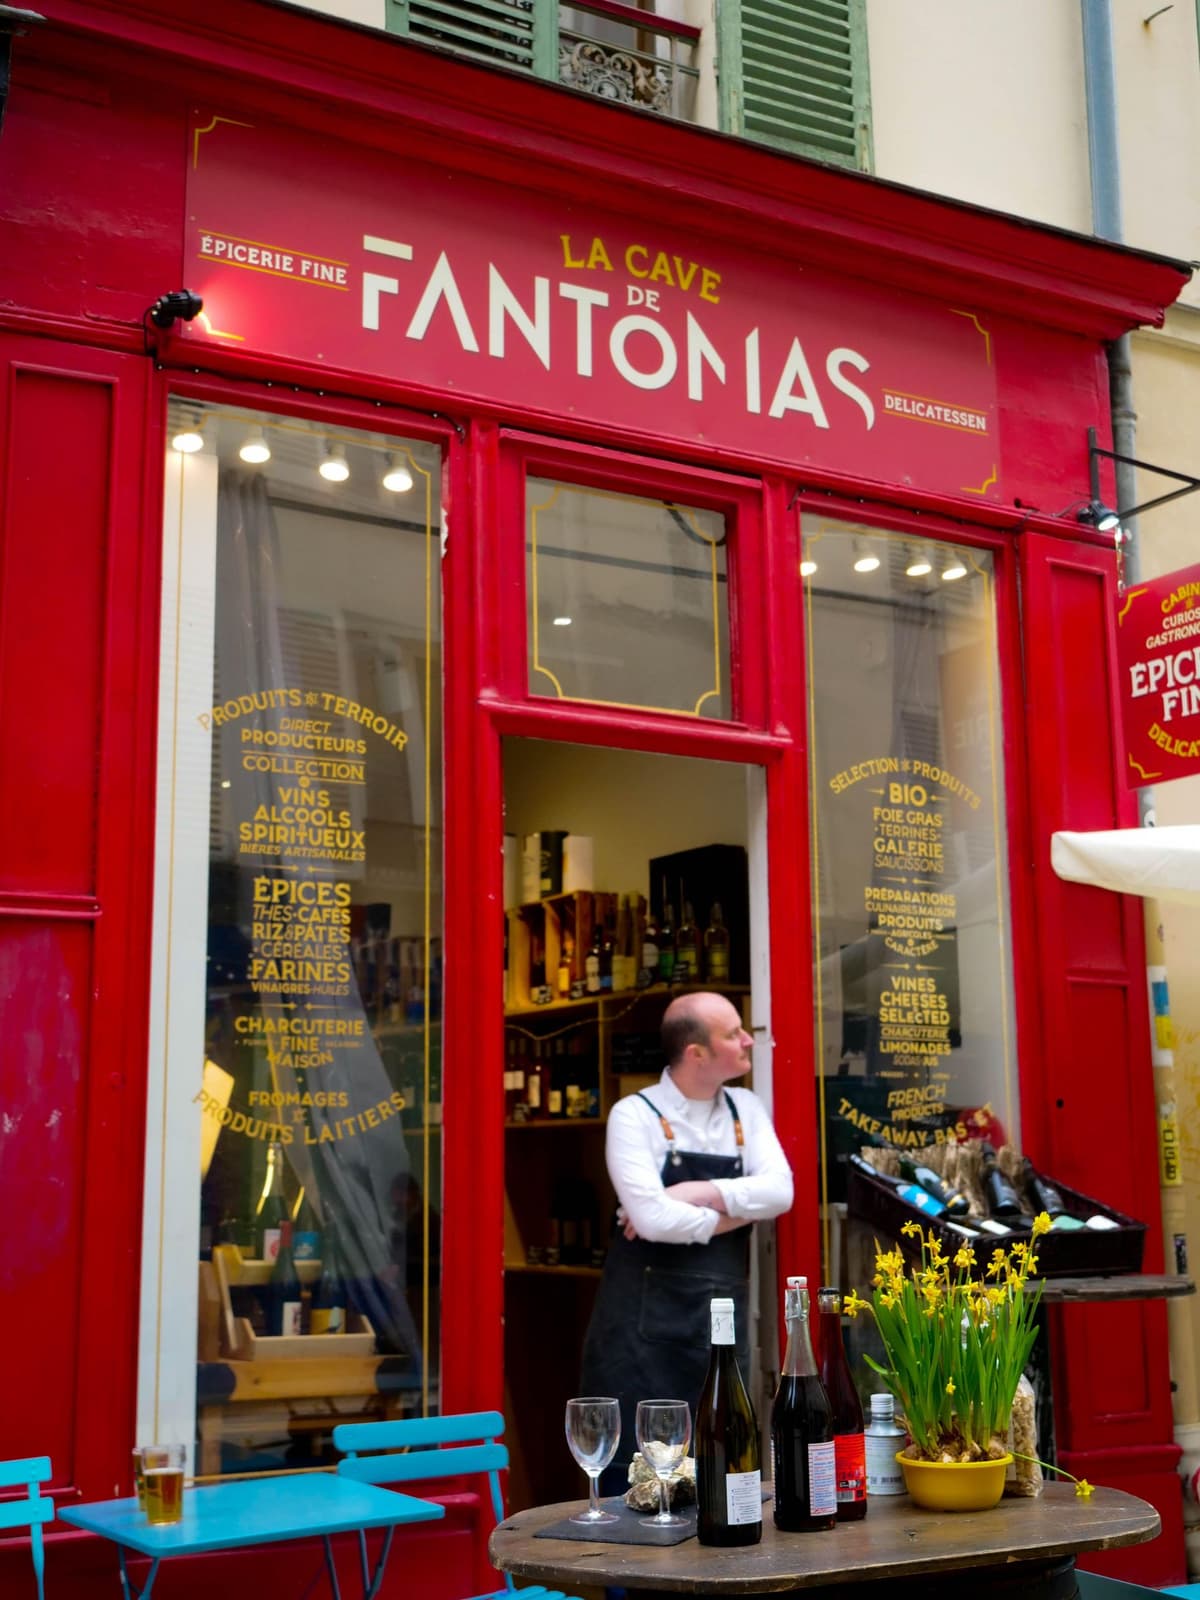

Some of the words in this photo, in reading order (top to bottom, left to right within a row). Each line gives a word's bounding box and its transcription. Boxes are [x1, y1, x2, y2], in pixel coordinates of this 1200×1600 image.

[200, 236, 294, 273] ÉPICERIE
[300, 260, 347, 284] FINE
[560, 235, 613, 271] LA
[625, 244, 721, 304] CAVE
[627, 284, 660, 312] DE
[362, 234, 875, 432] FANTOMAS
[884, 394, 987, 431] DELICATESSEN
[197, 689, 301, 732] PRODUITS
[321, 693, 409, 752] TERROIR
[280, 718, 332, 734] DIRECT
[241, 729, 368, 754] PRODUCTEURS
[243, 755, 365, 780] COLLECTION
[889, 782, 928, 807] BIO
[913, 760, 982, 810] PRODUITS
[278, 787, 331, 808] VINS
[254, 804, 352, 828] ALCOOLS
[873, 807, 904, 823] FOIE
[906, 810, 943, 828] GRAS
[240, 822, 366, 849] SPIRITUEUX
[880, 824, 937, 841] TERRINES
[284, 846, 367, 862] ARTISANALES
[253, 874, 352, 907] ÉPICES
[877, 914, 944, 931] PRODUITS
[251, 959, 350, 983] FARINES
[891, 975, 936, 993] VINES
[880, 991, 948, 1010] CHEESES
[235, 1016, 364, 1036] CHARCUTERIE
[880, 1007, 950, 1026] SELECTED
[280, 1036, 320, 1053] FINE
[880, 1040, 951, 1056] LIMONADES
[267, 1050, 335, 1068] MAISON
[249, 1091, 348, 1107] FROMAGES
[887, 1083, 946, 1109] FRENCH
[192, 1089, 294, 1145] PRODUITS
[304, 1091, 406, 1145] LAITIERS
[838, 1098, 929, 1147] TAKEAWAY
